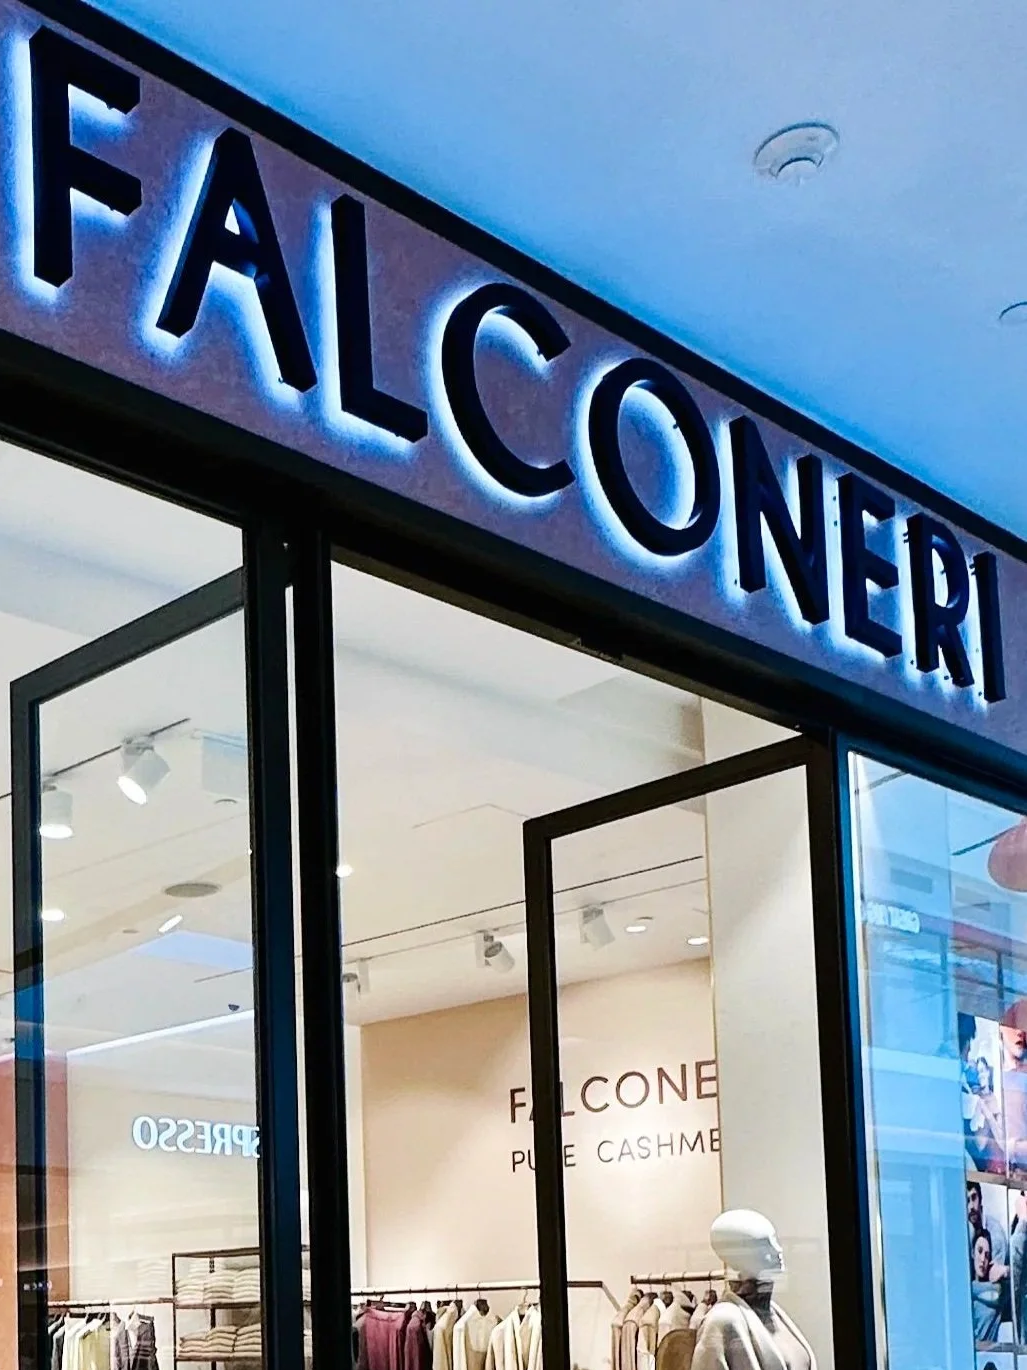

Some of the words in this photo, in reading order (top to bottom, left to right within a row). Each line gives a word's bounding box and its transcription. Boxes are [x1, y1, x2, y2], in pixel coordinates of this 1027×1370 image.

[28, 24, 1006, 704] FALCONERI
[510, 1060, 718, 1124] FLCONE
[512, 1144, 576, 1173] PUE
